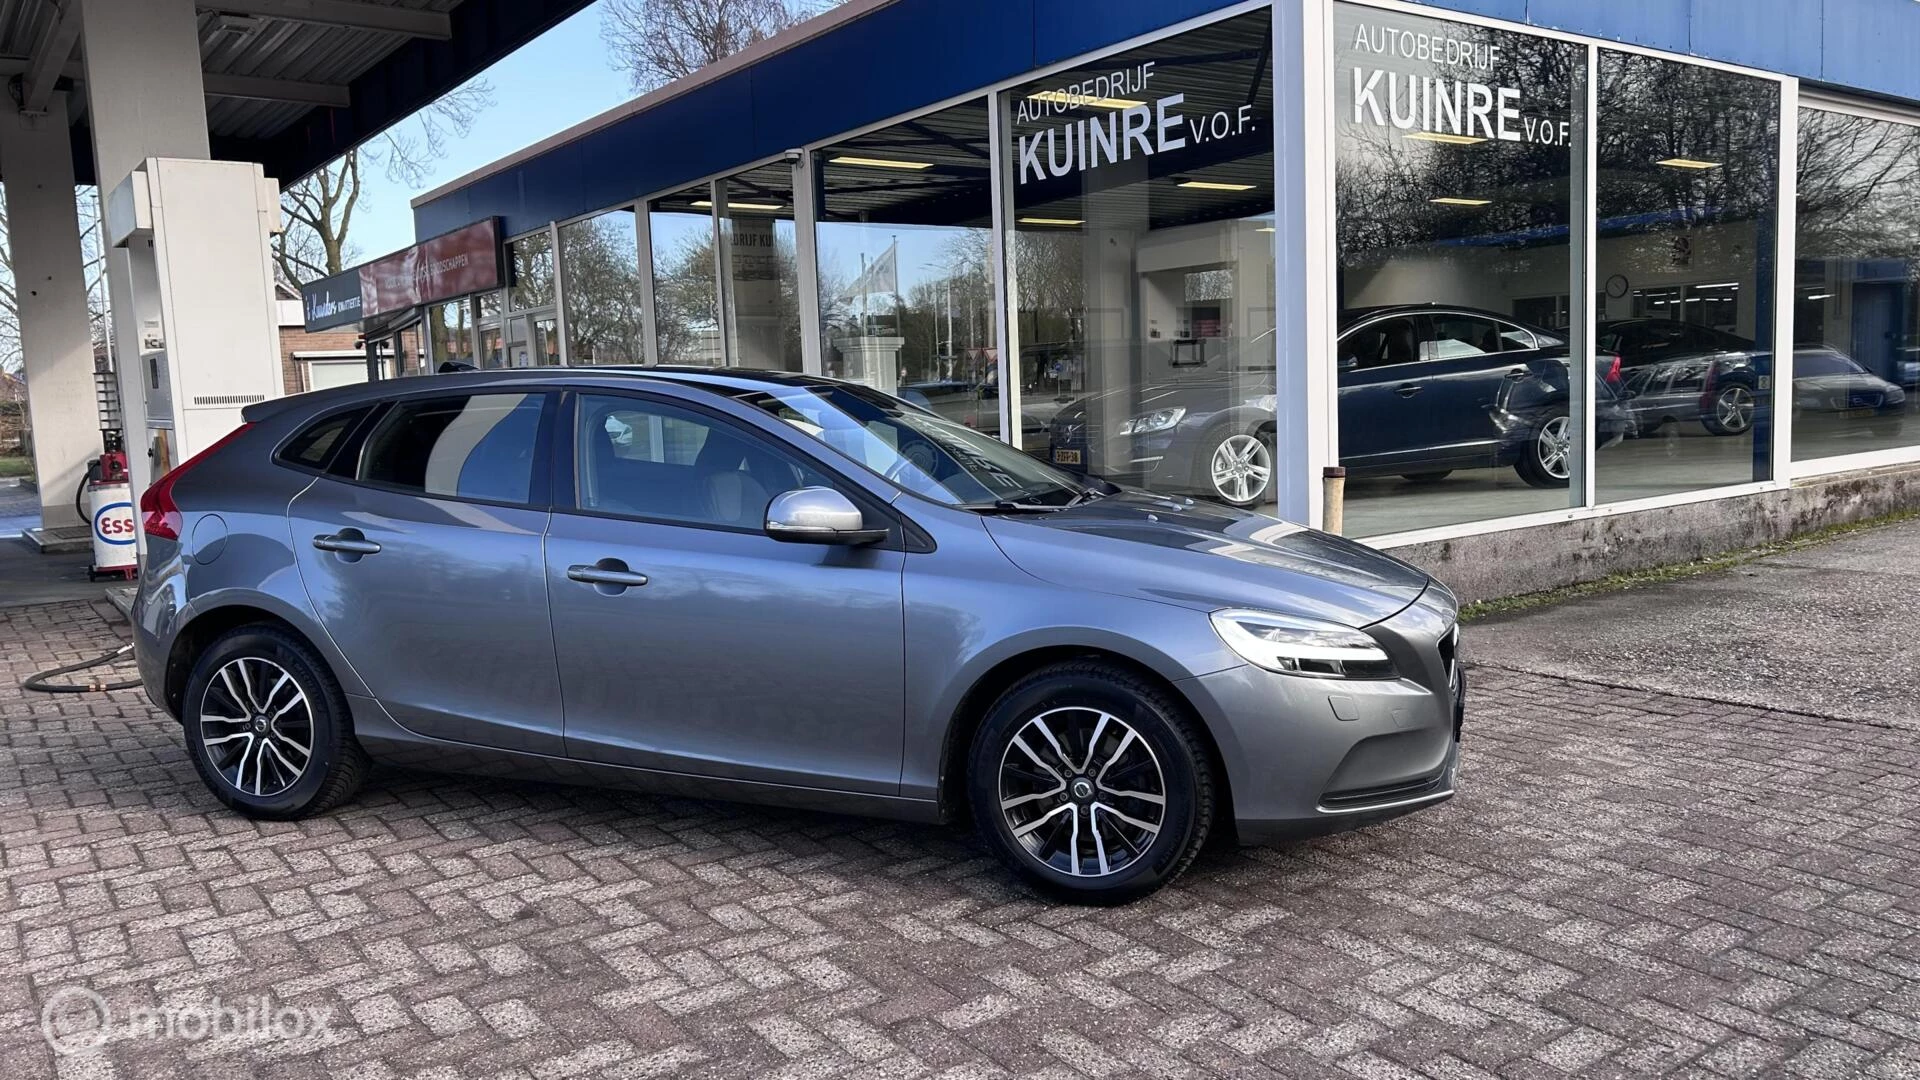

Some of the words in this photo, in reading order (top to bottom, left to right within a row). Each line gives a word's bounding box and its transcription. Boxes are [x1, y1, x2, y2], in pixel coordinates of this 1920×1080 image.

[1355, 23, 1501, 71] AUTOBEDRIJF
[1016, 61, 1156, 125] AUTOBEDRIJF
[1353, 66, 1521, 142] KUINRE
[1523, 116, 1572, 148] V.O.F.
[1018, 92, 1186, 185] KUINRE
[1189, 104, 1257, 145] V.O.F.
